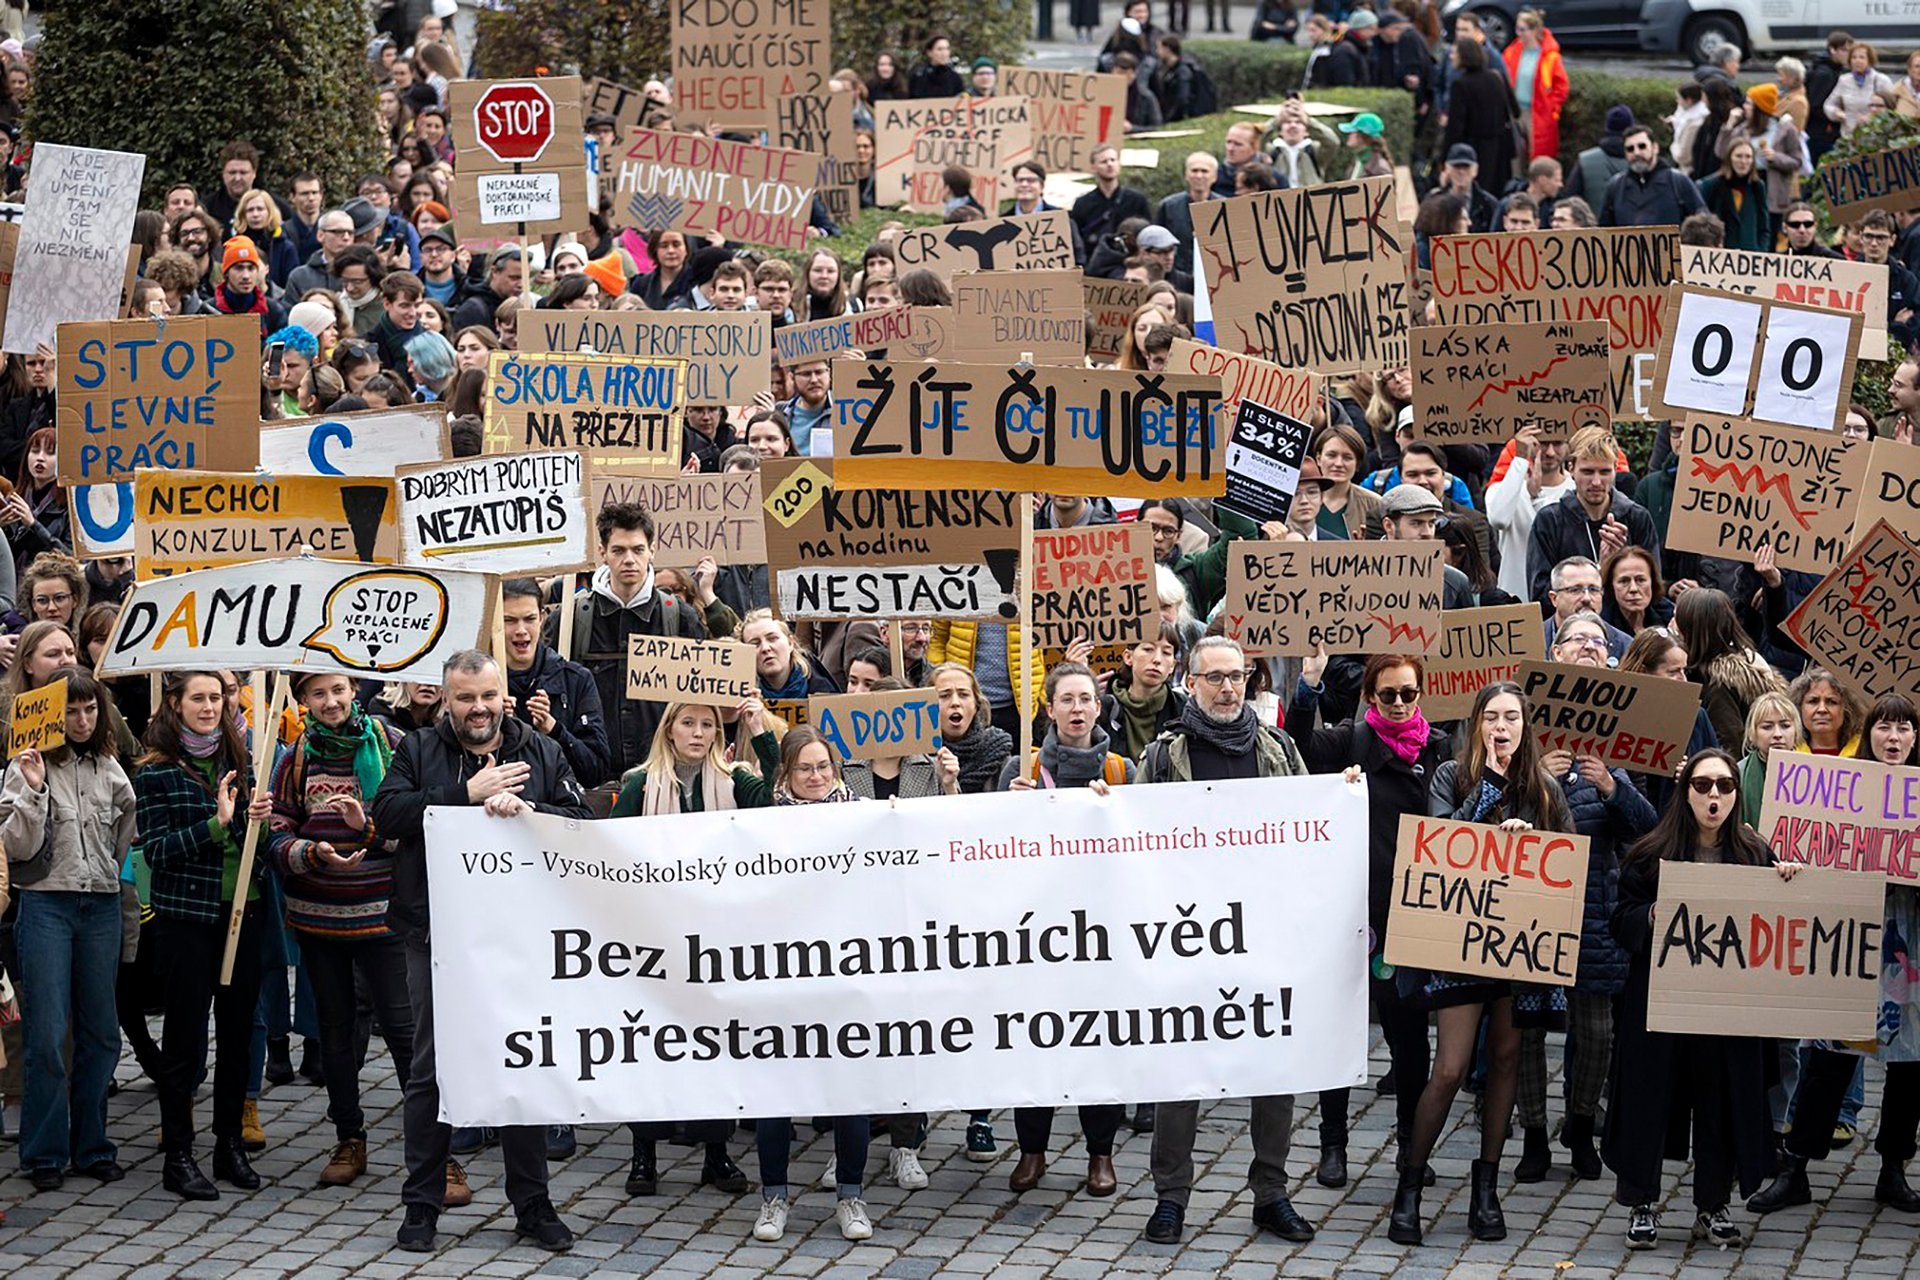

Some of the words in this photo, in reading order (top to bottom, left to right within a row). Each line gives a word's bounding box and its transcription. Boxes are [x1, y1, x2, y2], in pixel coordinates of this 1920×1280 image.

[679, 0, 758, 27] KDO
[679, 34, 762, 69] NAUČÍ
[763, 34, 821, 68] ČÍST
[1005, 70, 1098, 103] KONEC
[485, 98, 544, 138] STOP
[885, 98, 1029, 130] AKADEMICKÁ
[69, 151, 106, 170] KDE
[914, 138, 997, 169] DUCHEM
[60, 168, 109, 184] NENÍ
[67, 197, 101, 214] TAM
[68, 213, 92, 227] SE
[684, 200, 705, 231] Z
[59, 227, 91, 243] NIC
[1024, 217, 1056, 237] VZ
[1251, 183, 1402, 275] ÚVAZEK
[898, 230, 941, 265] ČR
[1432, 236, 1546, 298] ČESKO:
[1687, 249, 1834, 282] AKADEMICKÁ
[957, 287, 1054, 316] FINANCE
[1774, 281, 1873, 314] NENÍ
[544, 315, 626, 354] VLÁDA
[635, 318, 763, 357] PROFESORŮ
[854, 305, 913, 346] NESTAČÍ
[1545, 325, 1574, 339] ANI
[1421, 329, 1511, 357] LÁSKA
[1555, 337, 1609, 358] ZUBAŘE
[74, 339, 235, 389] STOP
[1419, 368, 1435, 385] K
[1446, 359, 1507, 385] PRÁCI
[494, 355, 595, 405] ŠKOLA
[602, 365, 676, 411] HROU
[1517, 382, 1608, 404] NEZAPLATÍ
[84, 380, 223, 434] LEVNÉ
[849, 364, 973, 456] ŽÍT
[995, 368, 1057, 466] ČI
[1100, 374, 1223, 482] UČIT
[922, 400, 970, 431] JE
[1426, 404, 1449, 416] ANI
[525, 411, 567, 448] NA
[571, 405, 680, 452] PŘEŽITÍ
[1257, 412, 1303, 440] SLEVA
[1423, 413, 1505, 437] KROUŽKY
[80, 430, 195, 478] PRÁCI
[1690, 421, 1856, 476] DŮSTOJNĚ
[402, 465, 489, 502] DOBRÝM
[493, 454, 580, 492] POCITEM
[601, 474, 754, 513] AKADEMICKÝ
[1800, 475, 1852, 509] ŽÍT
[148, 484, 281, 516] NECHCI
[774, 477, 813, 518] 200
[1680, 487, 1771, 521] JEDNU
[416, 489, 567, 546] NEZATOPÍŠ
[150, 526, 351, 555] KONZULTACE
[798, 540, 835, 561] na
[839, 532, 931, 557] hodinu
[1032, 529, 1130, 565] TUDIUM
[1718, 519, 1800, 558] PRÁCI
[1059, 554, 1148, 588] PRÁCE
[1243, 551, 1299, 581] BEZ
[1310, 549, 1441, 580] HUMANITNÍ
[351, 587, 418, 614] STOP
[795, 564, 981, 614] NESTAČÍ
[1032, 585, 1112, 621] PRÁCE
[1118, 583, 1152, 616] JE
[1244, 583, 1310, 620] VĚDY,
[1319, 584, 1410, 613] PŘIJDOU
[114, 583, 302, 654] DAMU
[342, 611, 434, 632] NEPLACENÉ
[1246, 619, 1291, 646] NÁS
[1308, 616, 1374, 649] BĚDY
[345, 628, 400, 644] PRÁCI
[633, 638, 732, 667] ZAPLAŤTE
[629, 664, 668, 689] NÁM
[676, 667, 751, 698] UČITELE
[1524, 671, 1638, 712] PLNOU
[15, 696, 49, 721] Konec
[820, 707, 852, 760] A
[850, 700, 943, 749] DOST!
[1608, 732, 1678, 771] BEK
[1774, 761, 1863, 813] KONEC
[460, 850, 514, 875] VOS
[541, 849, 728, 885] Vysokoškolský
[733, 845, 857, 878] odborový
[862, 846, 919, 869] svaz
[948, 835, 1043, 864] Fakulta
[1049, 825, 1208, 858] humanitních
[1214, 820, 1288, 848] studií
[1292, 819, 1332, 844] UK
[1414, 819, 1575, 889] KONEC
[1400, 864, 1511, 922] LEVNÉ
[550, 927, 668, 981] Bez
[684, 909, 1113, 984] humanitních
[1129, 901, 1249, 960] věd
[1461, 918, 1580, 978] PRÁCE
[1656, 902, 1883, 980] AKADIEMIE
[504, 1015, 557, 1069] si
[576, 1009, 974, 1082] přestaneme
[993, 986, 1294, 1051] rozumět!
